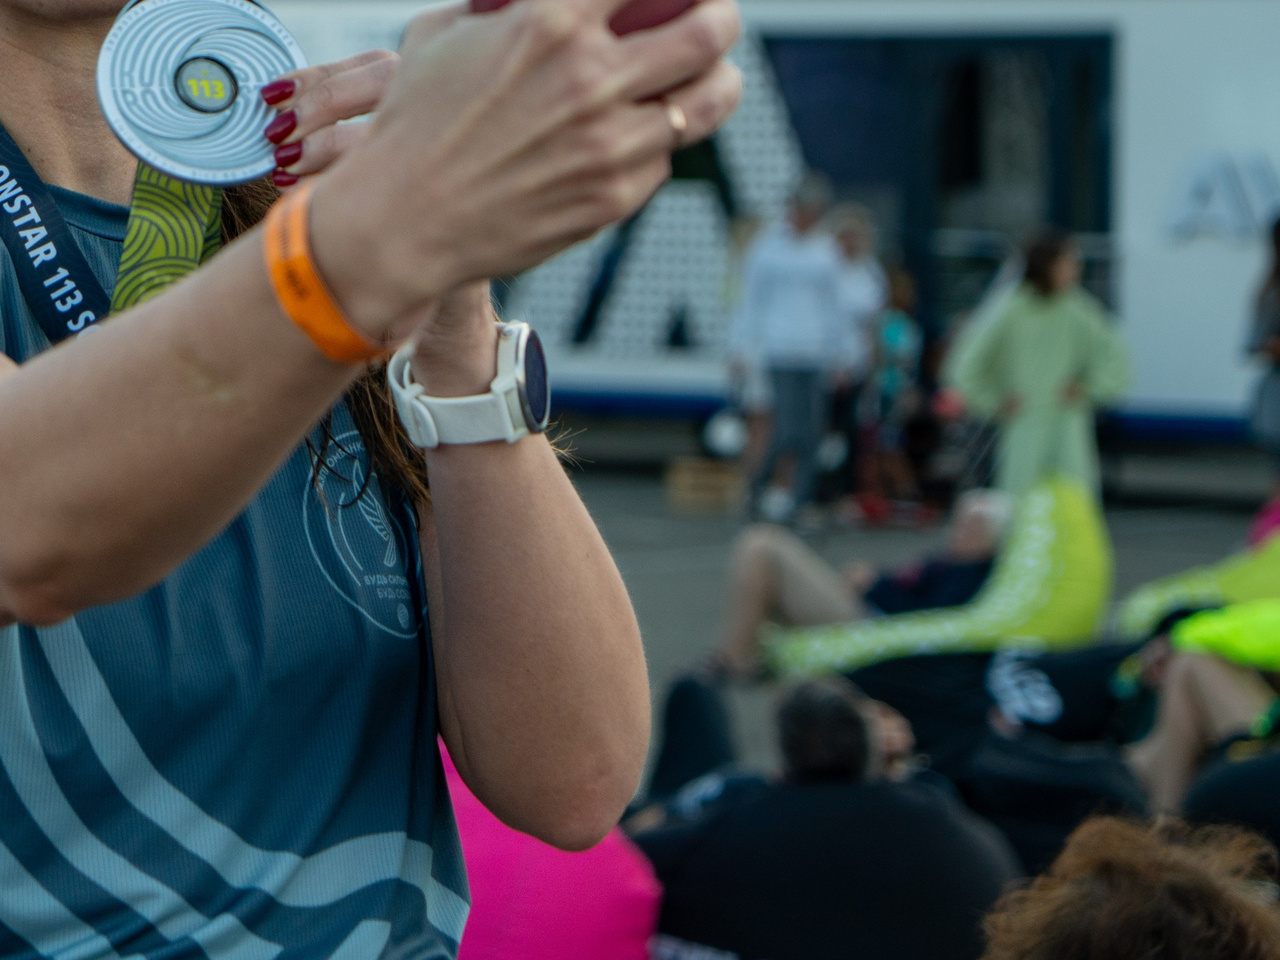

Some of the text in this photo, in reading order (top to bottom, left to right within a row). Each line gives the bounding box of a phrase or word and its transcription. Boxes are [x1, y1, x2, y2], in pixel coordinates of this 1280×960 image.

[187, 78, 225, 99] 113
[43, 267, 83, 312] 113
[67, 310, 101, 339] S
